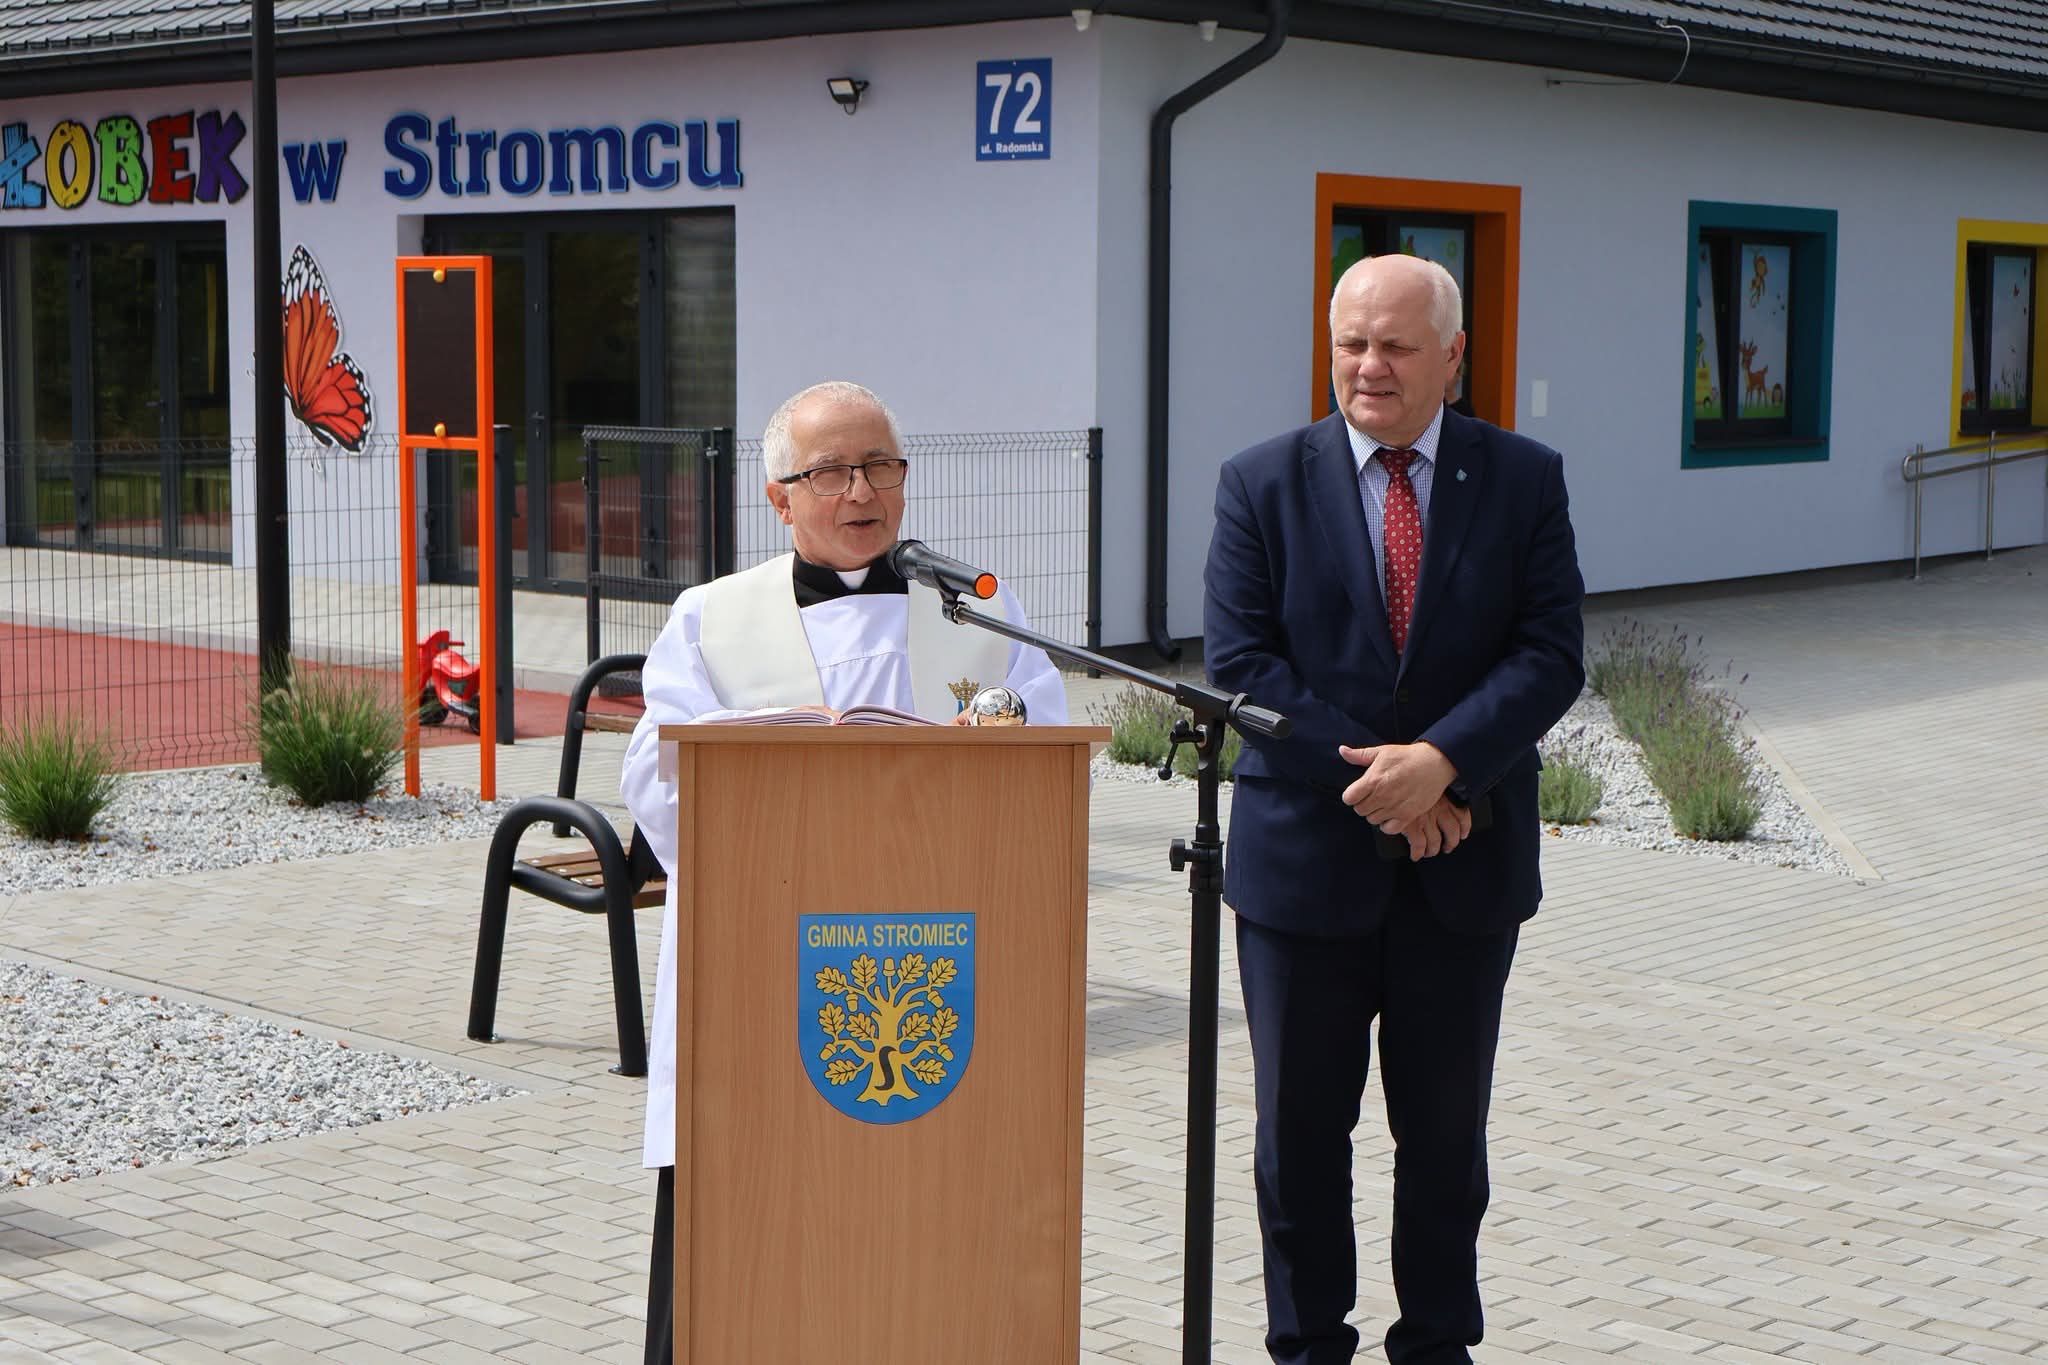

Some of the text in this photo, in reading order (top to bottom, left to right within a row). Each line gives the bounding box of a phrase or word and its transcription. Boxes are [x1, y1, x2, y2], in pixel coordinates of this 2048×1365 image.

[985, 72, 1042, 134] 72
[283, 139, 347, 203] w
[384, 111, 743, 200] Stromcu
[981, 141, 1044, 154] ul. Radomska
[807, 923, 968, 947] GMINA STROMIEC
